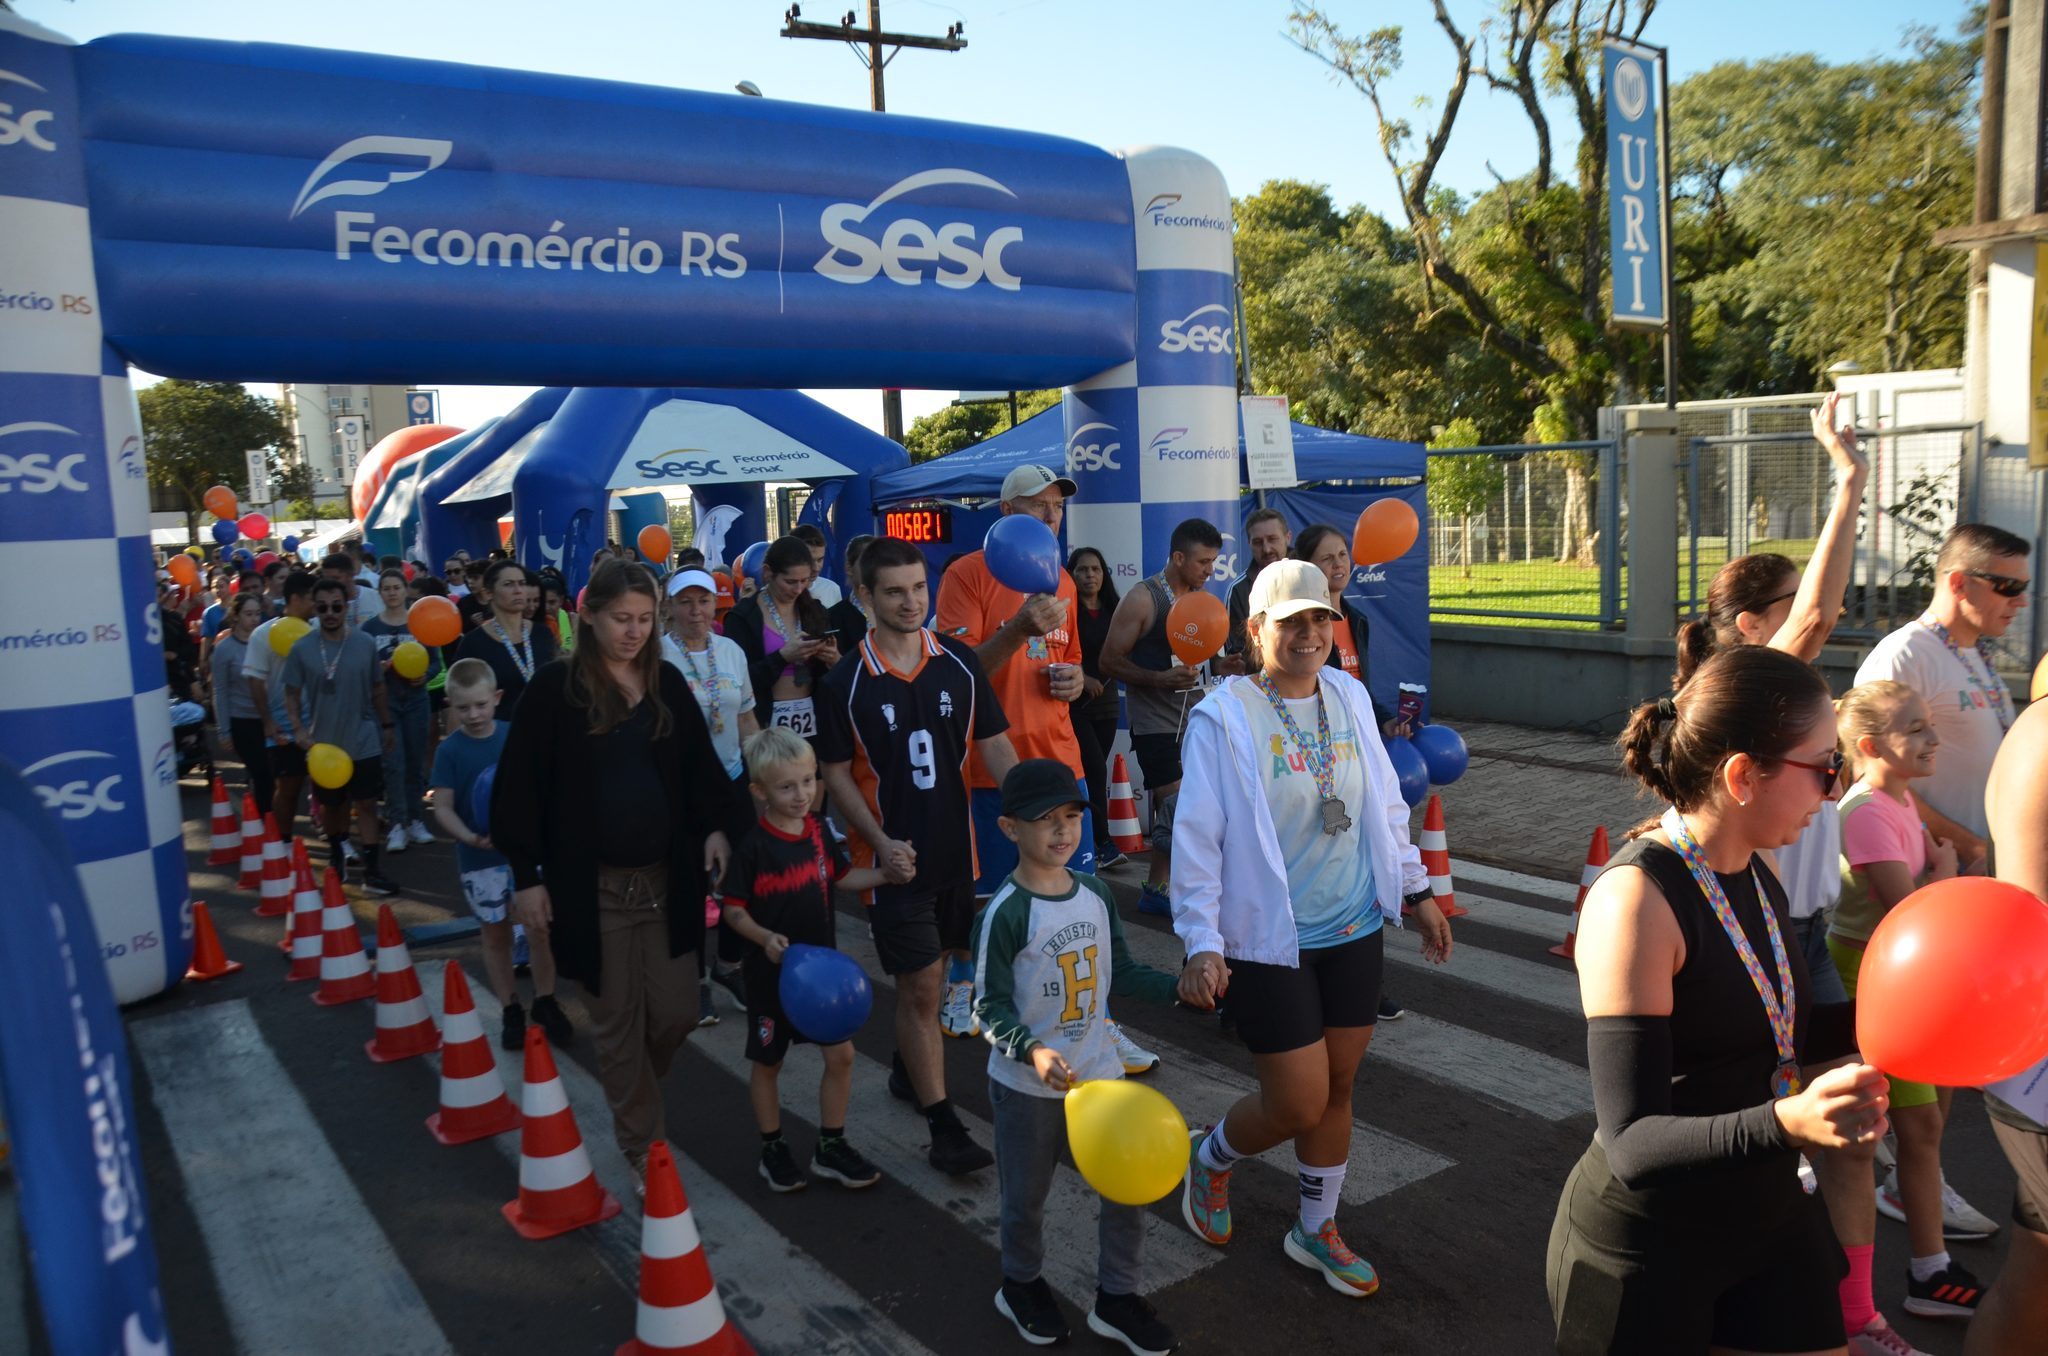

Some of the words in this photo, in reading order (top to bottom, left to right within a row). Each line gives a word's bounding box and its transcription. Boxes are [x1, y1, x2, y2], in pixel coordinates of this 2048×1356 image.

[1153, 213, 1226, 232] Fecomércio
[1618, 133, 1651, 313] URI
[334, 210, 664, 275] Fecomércio
[680, 230, 748, 279] RS
[812, 202, 1024, 292] Sesc
[60, 294, 92, 315] RS
[1158, 318, 1232, 355] Sesc
[635, 459, 727, 479] Sesc
[733, 451, 810, 464] Fecomércio
[1159, 447, 1231, 461] Fecomércio
[0, 453, 90, 494] esc
[1116, 563, 1138, 577] RS
[94, 624, 122, 643] RS
[1173, 631, 1206, 648] CRESOL
[908, 728, 937, 790] 9
[1048, 924, 1098, 953] HOUSTON
[1042, 981, 1060, 997] 19
[1056, 943, 1098, 1024] H
